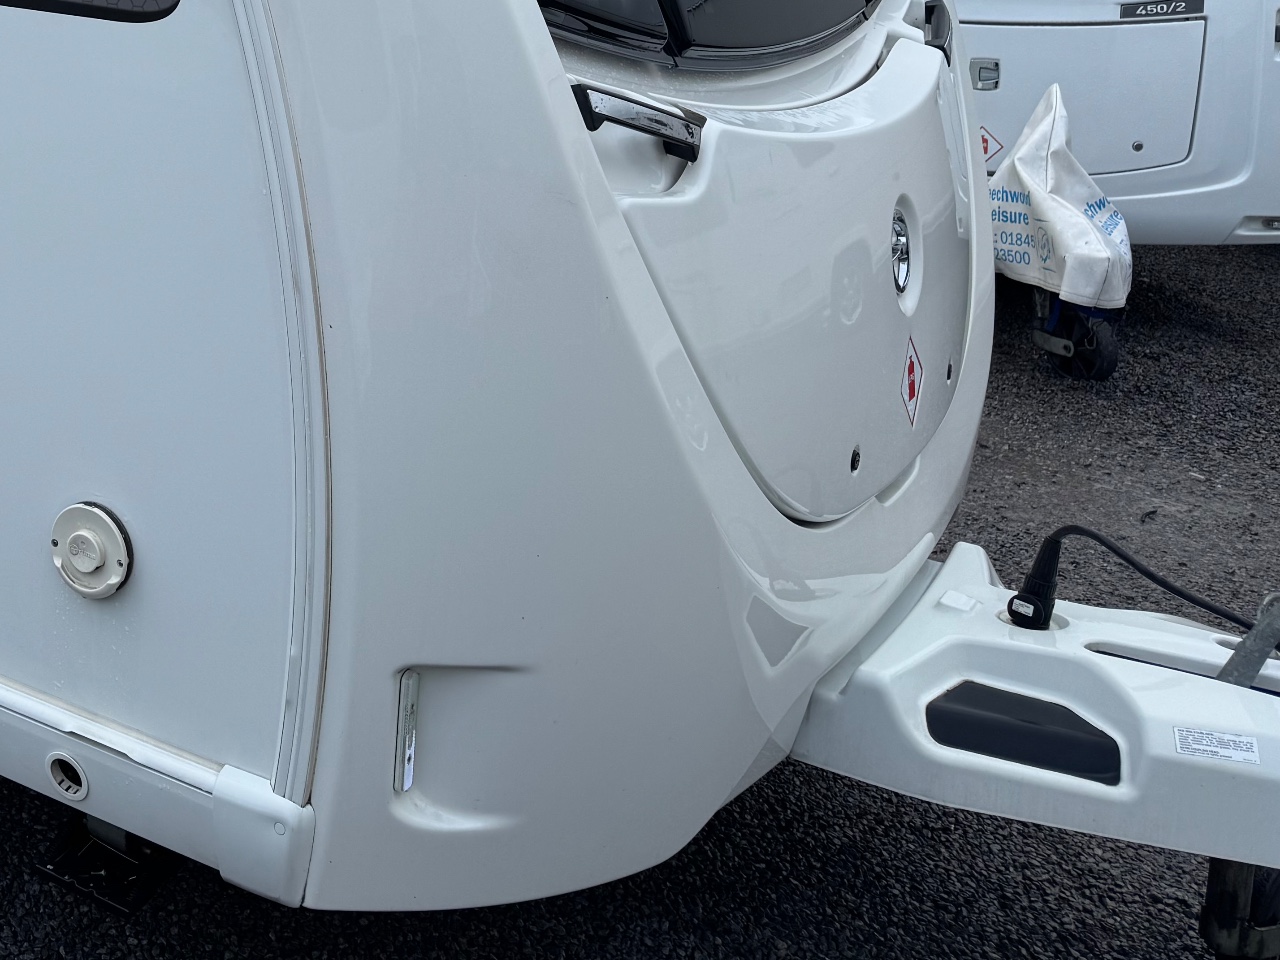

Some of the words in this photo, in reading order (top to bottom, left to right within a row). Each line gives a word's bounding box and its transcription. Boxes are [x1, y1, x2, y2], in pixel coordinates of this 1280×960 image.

[1135, 2, 1186, 15] 450/2
[991, 206, 1030, 226] eisure
[994, 247, 1031, 265] 23500
